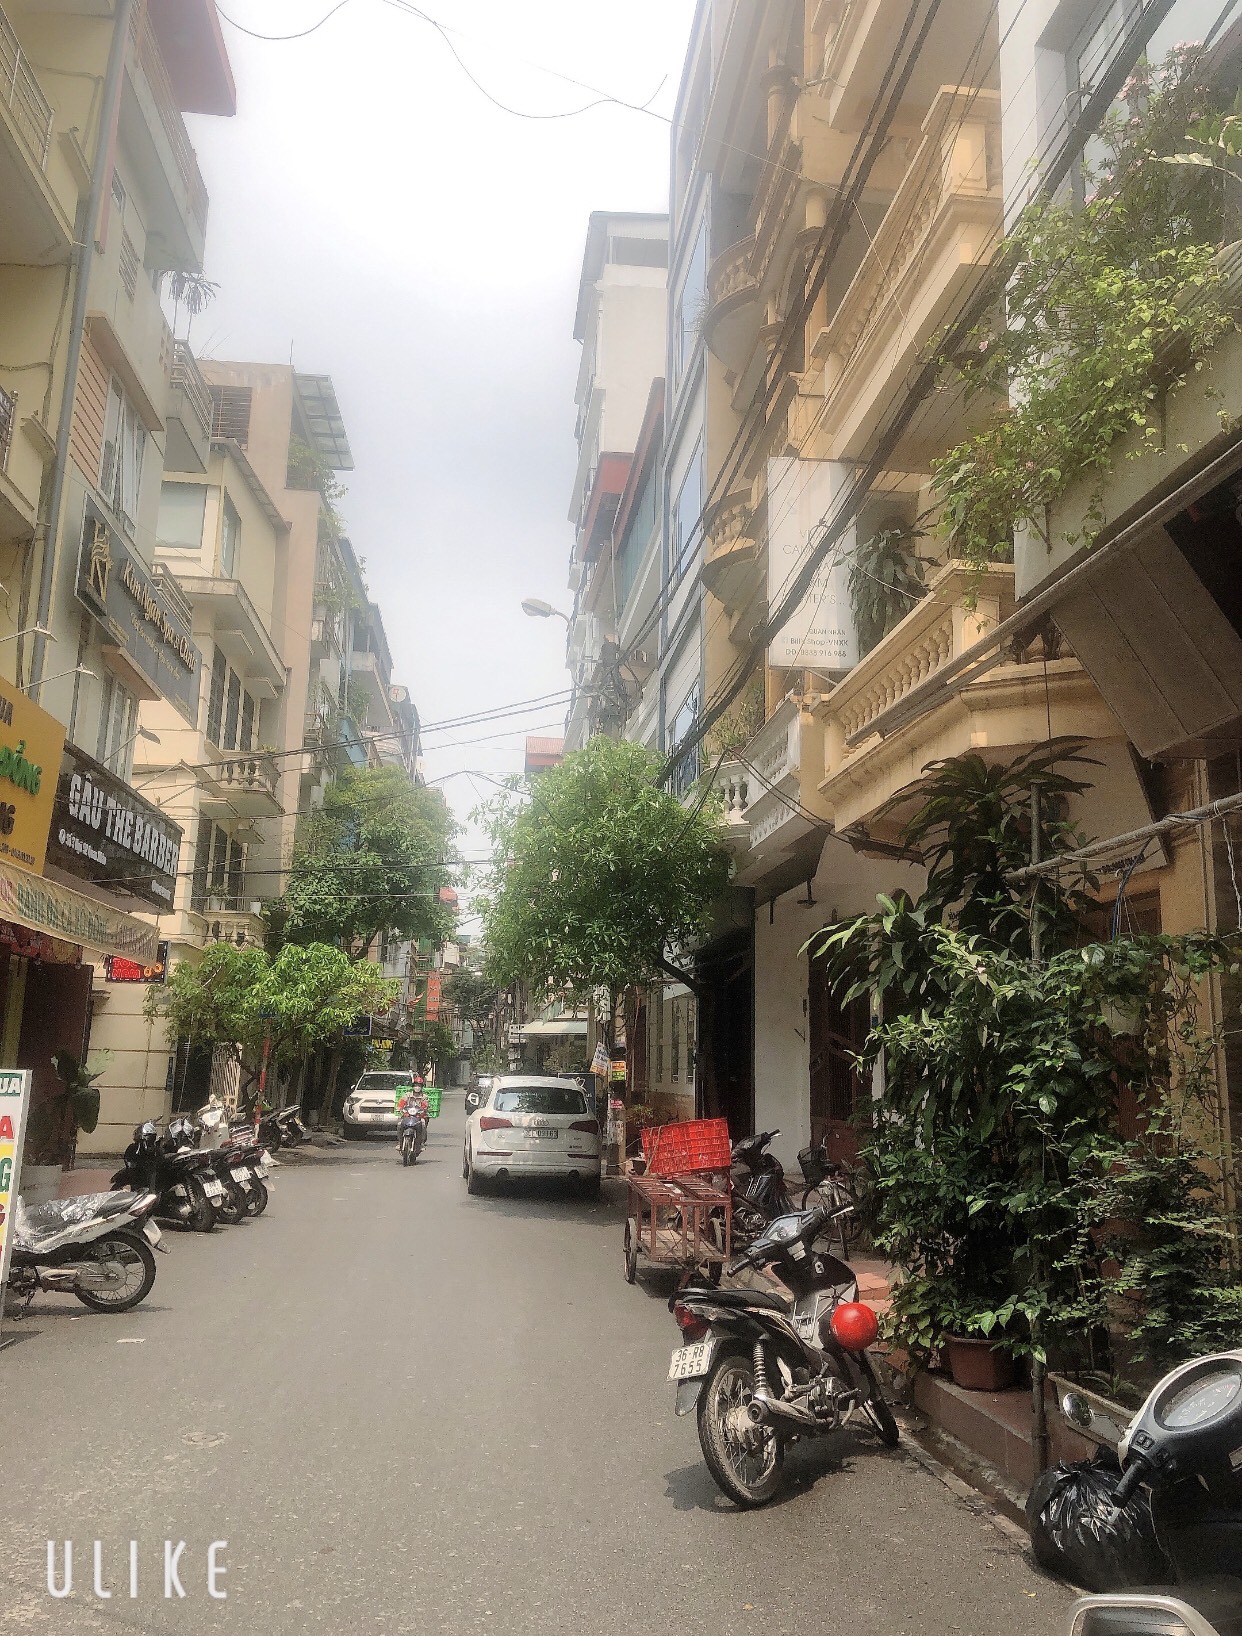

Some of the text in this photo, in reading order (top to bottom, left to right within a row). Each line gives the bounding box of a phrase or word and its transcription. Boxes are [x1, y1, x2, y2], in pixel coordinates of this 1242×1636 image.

[105, 796, 134, 850] THE
[133, 816, 180, 879] BARBER
[672, 1359, 703, 1378] 7655
